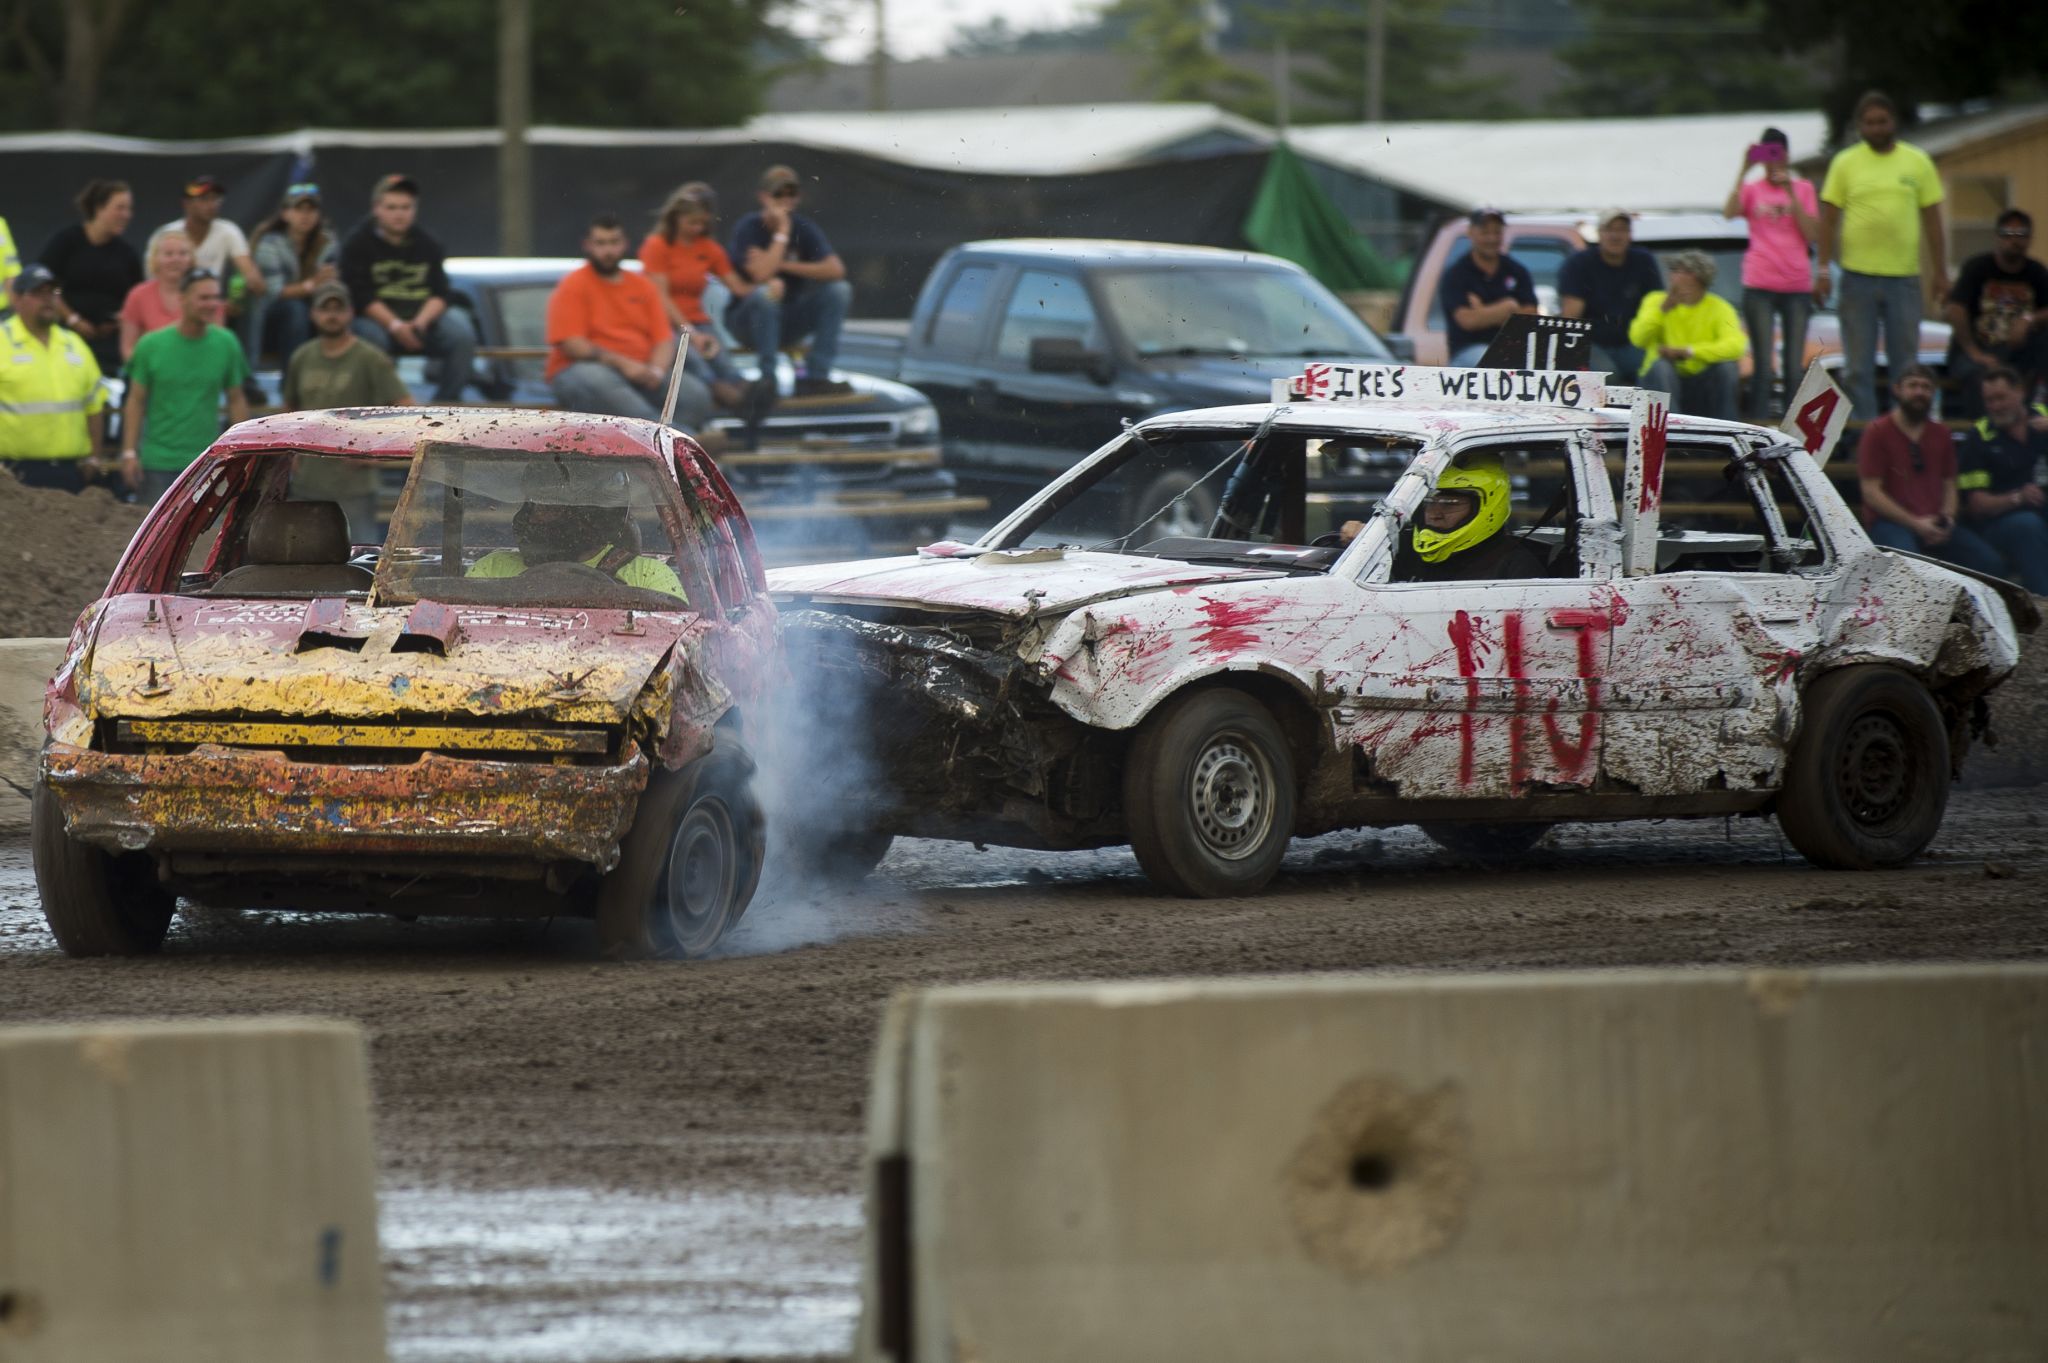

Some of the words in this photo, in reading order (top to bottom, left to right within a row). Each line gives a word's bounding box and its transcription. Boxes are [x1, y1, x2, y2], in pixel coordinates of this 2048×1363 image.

[1333, 366, 1405, 398] IKE'S
[1439, 370, 1581, 407] WELDING
[1794, 387, 1840, 455] 4
[207, 615, 303, 623] SALVA
